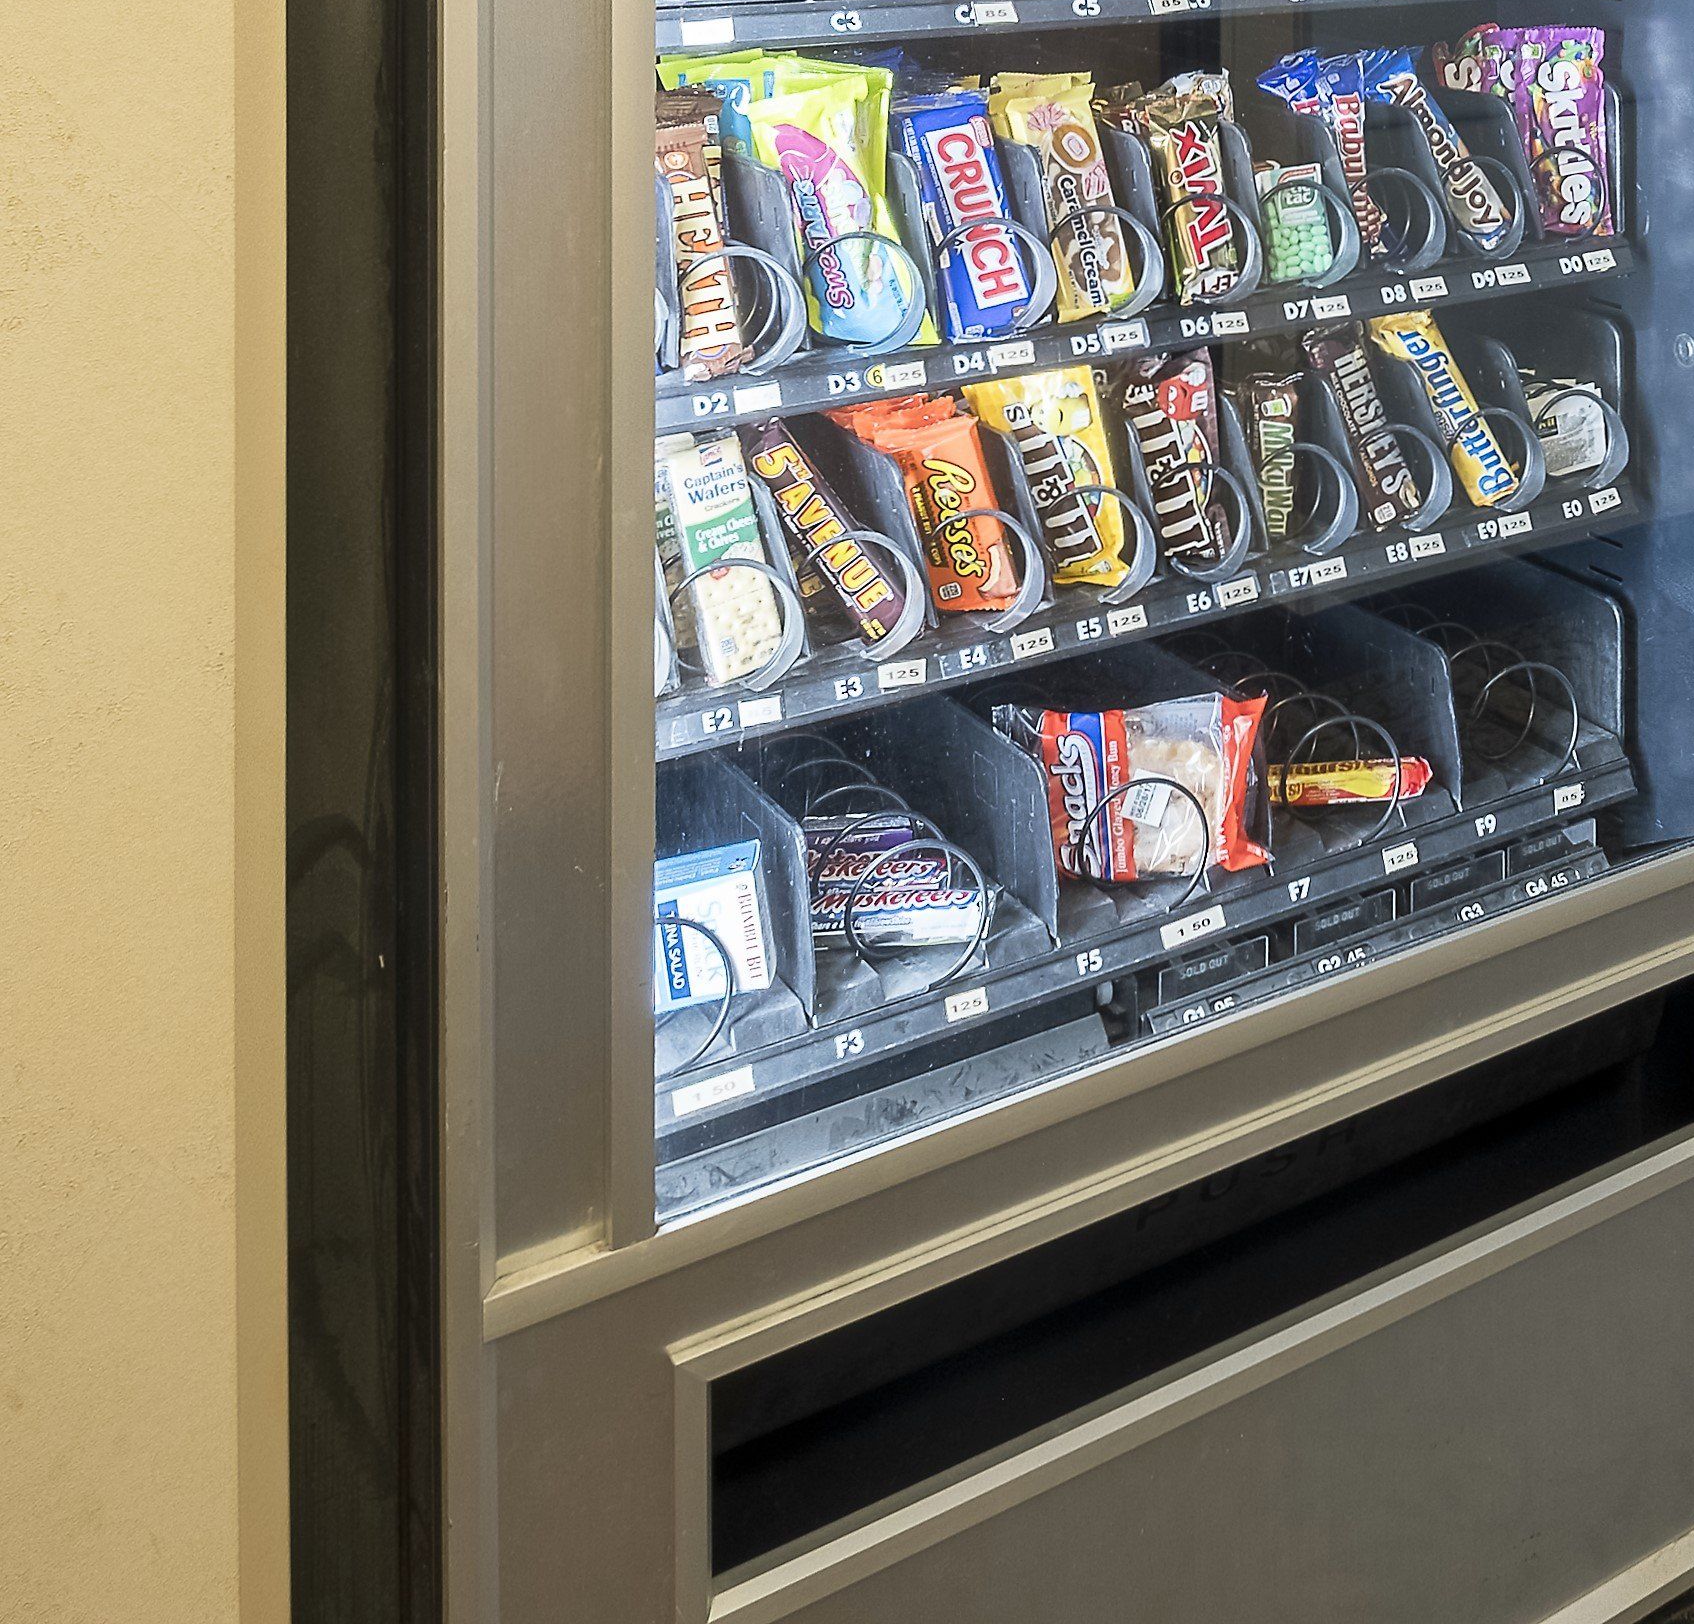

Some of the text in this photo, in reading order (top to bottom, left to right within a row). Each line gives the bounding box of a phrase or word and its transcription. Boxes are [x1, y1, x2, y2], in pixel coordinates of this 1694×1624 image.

[830, 11, 863, 32] C3
[1377, 73, 1475, 181] Almond
[1452, 171, 1504, 226] Joy
[1538, 60, 1595, 225] Skittles
[1169, 121, 1234, 269] TWIX
[1285, 194, 1312, 205] tac
[938, 133, 1019, 300] CRUNCH
[1059, 176, 1103, 305] Caramel Cream
[1586, 254, 1611, 266] 125
[1472, 269, 1526, 290] D9 125
[1380, 285, 1407, 304] D8
[1283, 300, 1345, 320] D7 125
[1180, 316, 1246, 337] D6 125
[1070, 329, 1139, 356] D5 125
[952, 348, 1030, 375] D4 125
[828, 368, 923, 395] D3 125
[692, 394, 729, 416] D2
[1396, 331, 1514, 497] Butterfinger
[1259, 420, 1295, 487] Milky
[684, 463, 744, 489] Captain's
[688, 479, 746, 504] Wafers
[1477, 518, 1528, 539] E9 125
[774, 480, 895, 613] AVENUE
[1385, 544, 1410, 564] E8
[1289, 567, 1312, 588] E7
[1186, 585, 1253, 614] E6 125
[1076, 618, 1104, 641] E5
[959, 649, 988, 670] E4
[834, 668, 920, 701] E3 125
[701, 707, 734, 734] E2
[1106, 740, 1129, 874] Jumbo Glazed Bun
[1475, 814, 1498, 837] F9
[1388, 850, 1415, 865] 125
[1288, 878, 1311, 903] F7
[1525, 871, 1569, 897] G4 45
[1191, 917, 1211, 931] 50
[1460, 902, 1484, 921] G3
[669, 948, 686, 991] SALAD
[1076, 949, 1103, 976] F5
[1317, 957, 1343, 974] G2
[834, 1031, 865, 1060] F3
